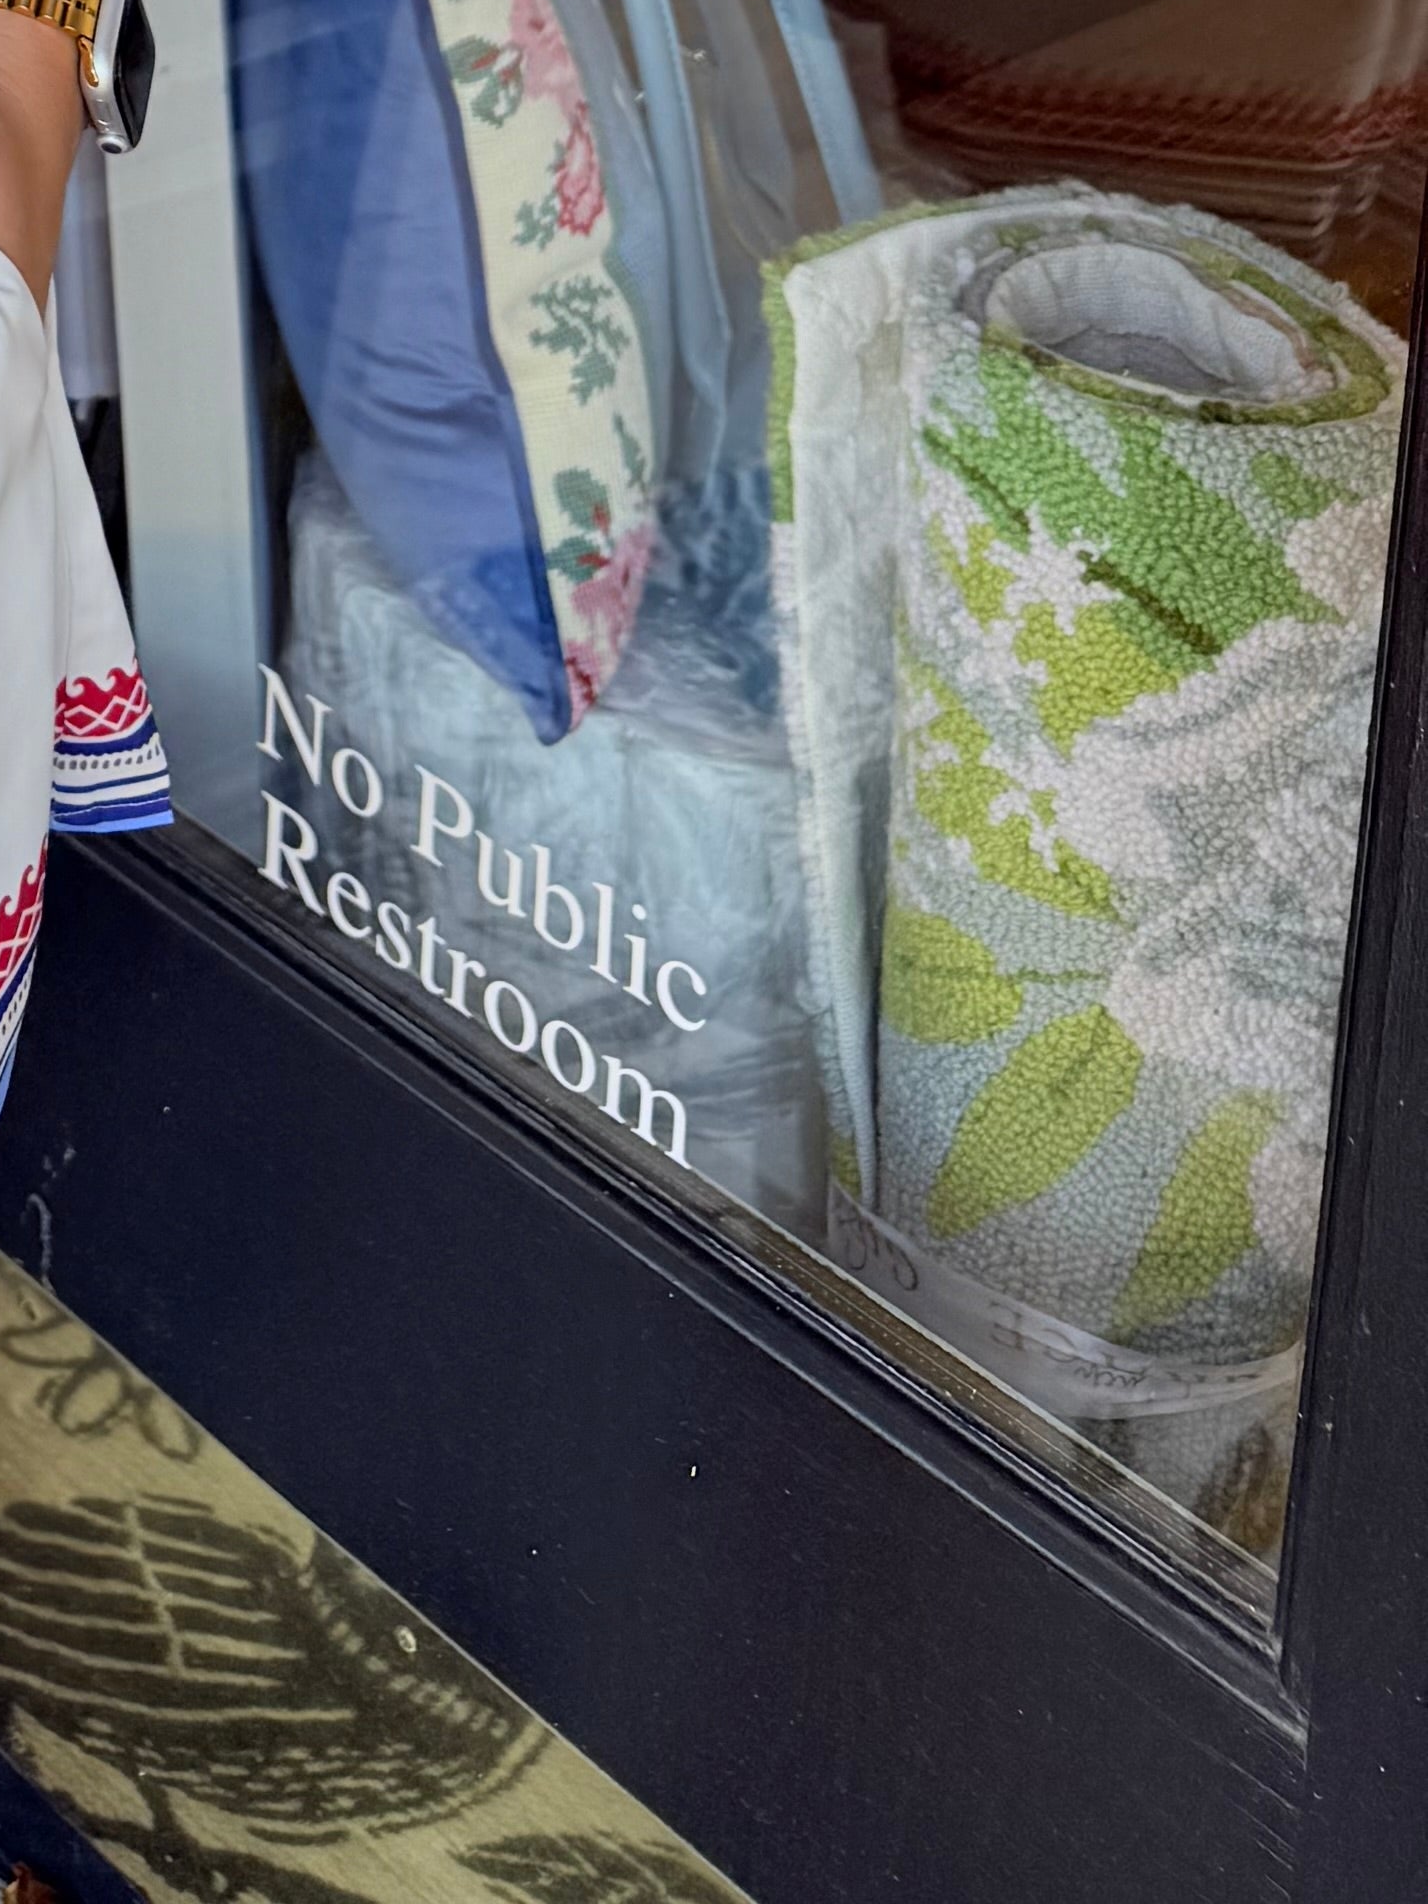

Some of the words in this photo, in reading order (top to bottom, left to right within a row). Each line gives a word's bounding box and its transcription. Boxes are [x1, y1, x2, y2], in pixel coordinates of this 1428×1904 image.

[256, 664, 384, 818] No
[410, 764, 708, 1032] Public
[256, 790, 694, 1170] Restroom
